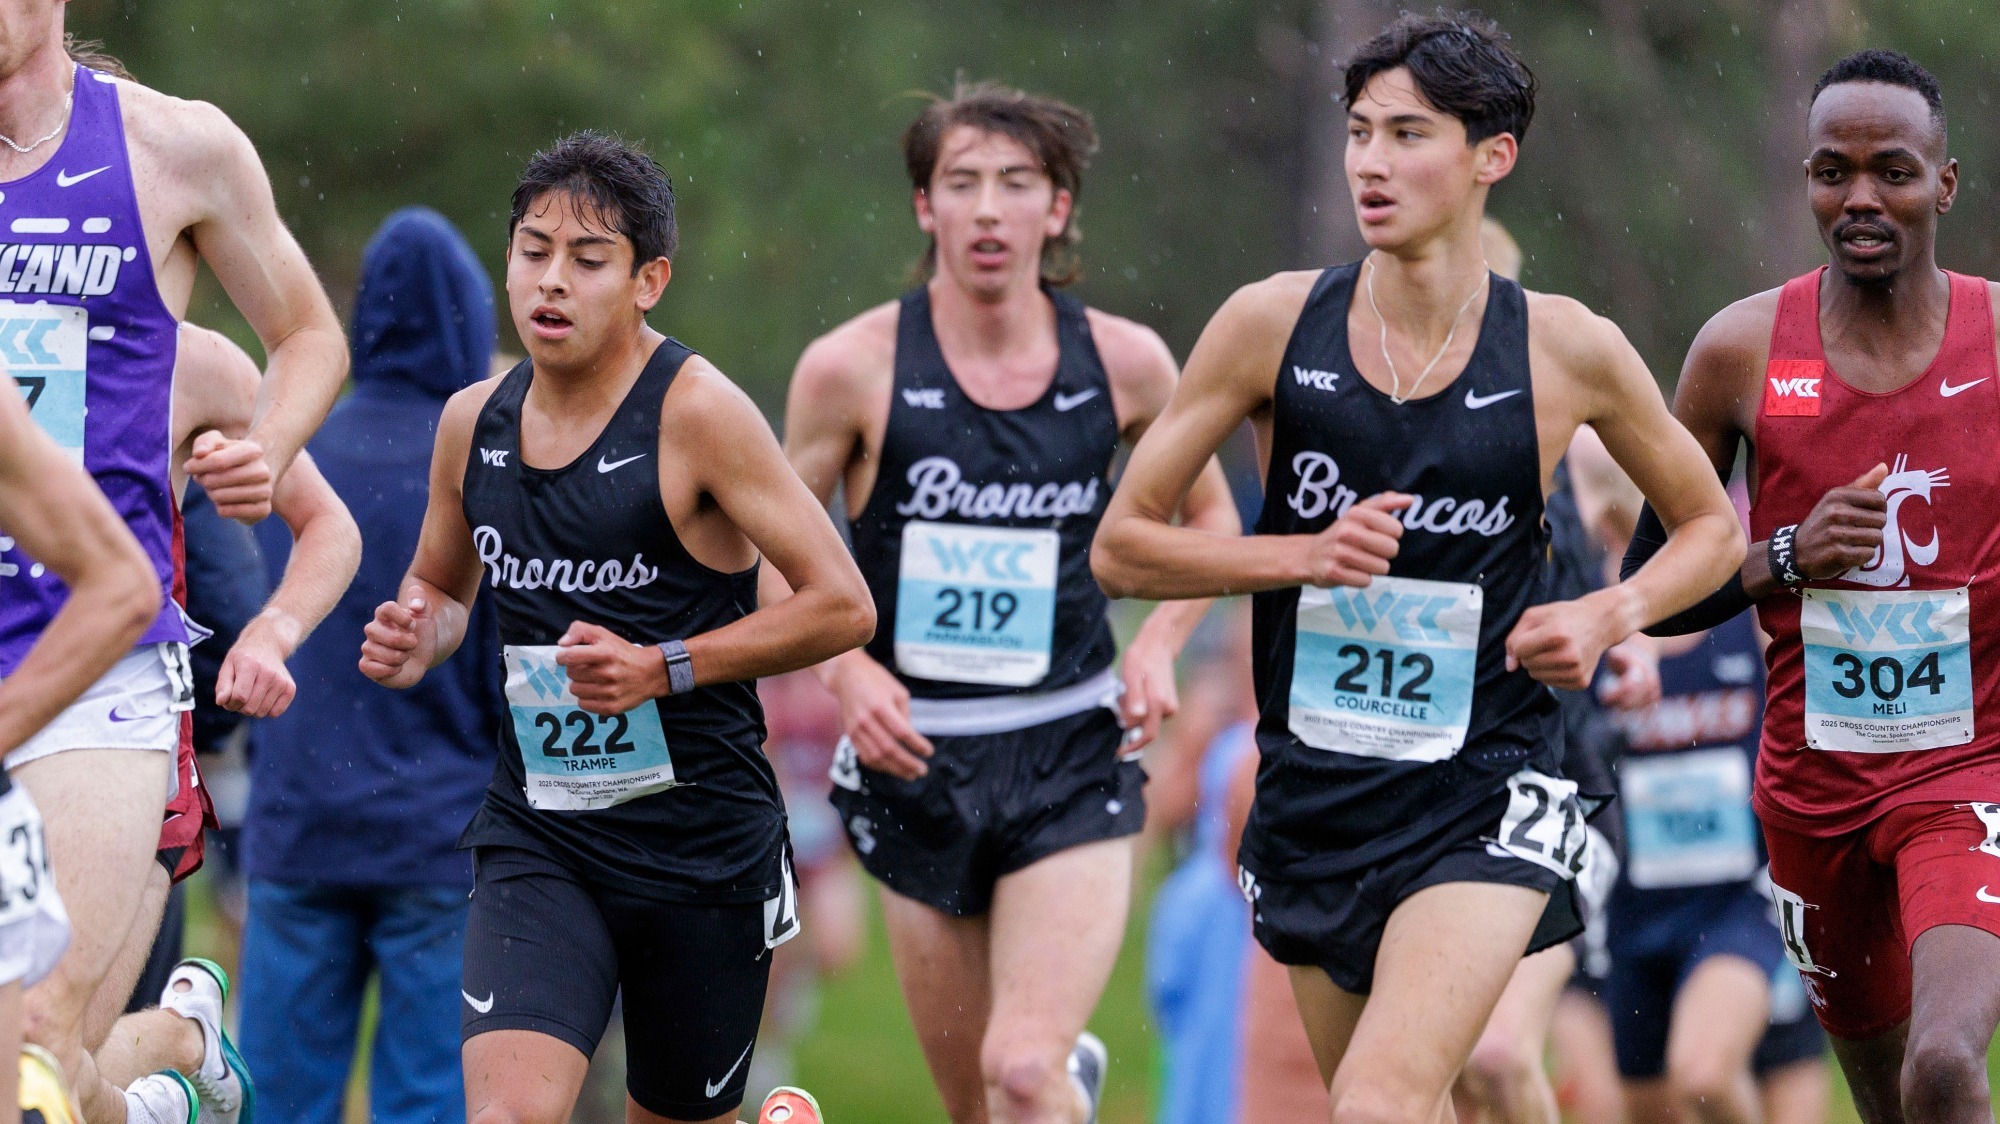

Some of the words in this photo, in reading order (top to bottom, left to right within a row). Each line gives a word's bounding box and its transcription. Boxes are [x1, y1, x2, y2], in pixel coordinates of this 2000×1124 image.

[0, 243, 122, 296] LAND
[0, 318, 63, 365] CC
[901, 387, 945, 409] WCC
[1293, 365, 1340, 392] WCC
[1770, 377, 1821, 398] WCC
[479, 447, 510, 468] WCC
[896, 456, 1099, 519] Broncos
[1287, 451, 1515, 537] Brncos
[927, 536, 1037, 582] WCC
[934, 588, 1018, 632] 219
[1330, 585, 1459, 643] WCC
[1827, 600, 1947, 645] WCC
[1334, 643, 1435, 703] 212
[1832, 651, 1946, 701] 304
[1335, 695, 1428, 720] COURCELLE
[1820, 719, 1838, 728] 2025
[1839, 721, 1863, 730] CROSS
[1864, 724, 1900, 732] COUNTRY
[1901, 716, 1961, 731] CHAMPIONSHIPS
[1873, 702, 1907, 715] MELI
[535, 710, 636, 757] 222
[538, 780, 553, 788] 2025
[553, 781, 571, 789] CROSS
[571, 781, 601, 789] COUNTRY
[602, 772, 661, 788] CHAMPIONSHIPS
[563, 757, 617, 772] TRAMPE
